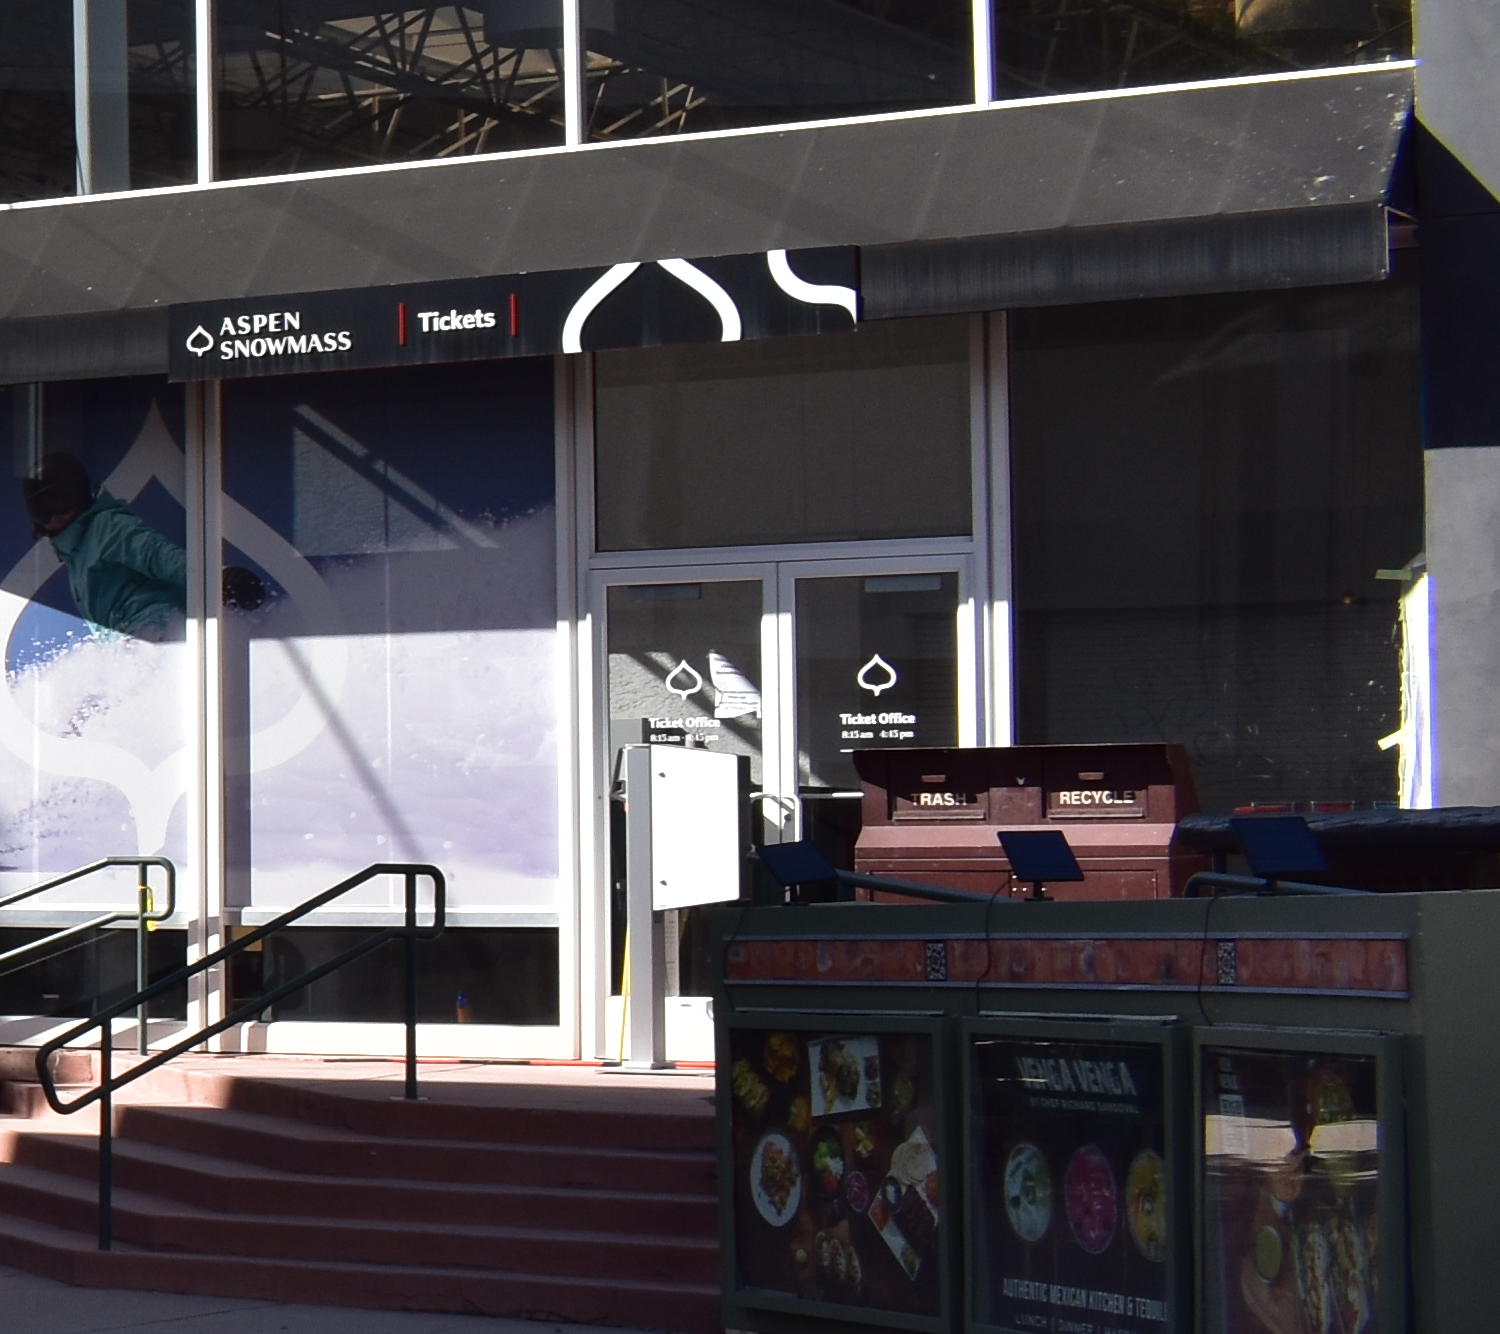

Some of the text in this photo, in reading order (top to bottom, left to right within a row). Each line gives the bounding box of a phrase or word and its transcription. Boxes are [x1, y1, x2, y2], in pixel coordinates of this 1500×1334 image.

[220, 311, 301, 336] ASPEN
[417, 309, 497, 333] Tickets
[220, 331, 352, 361] SNOWMASS
[648, 716, 721, 729] Ticket Office
[839, 712, 916, 725] Ticket Office
[910, 792, 968, 807] TRASH
[1059, 790, 1136, 805] RECYCLE
[1015, 1056, 1138, 1096] VENGA VENGA
[1003, 1277, 1048, 1303] AUTHENTIC
[1049, 1284, 1088, 1309] MEXICAN
[1088, 1290, 1126, 1315] KITCHEN
[1015, 1313, 1048, 1328] LUNCH
